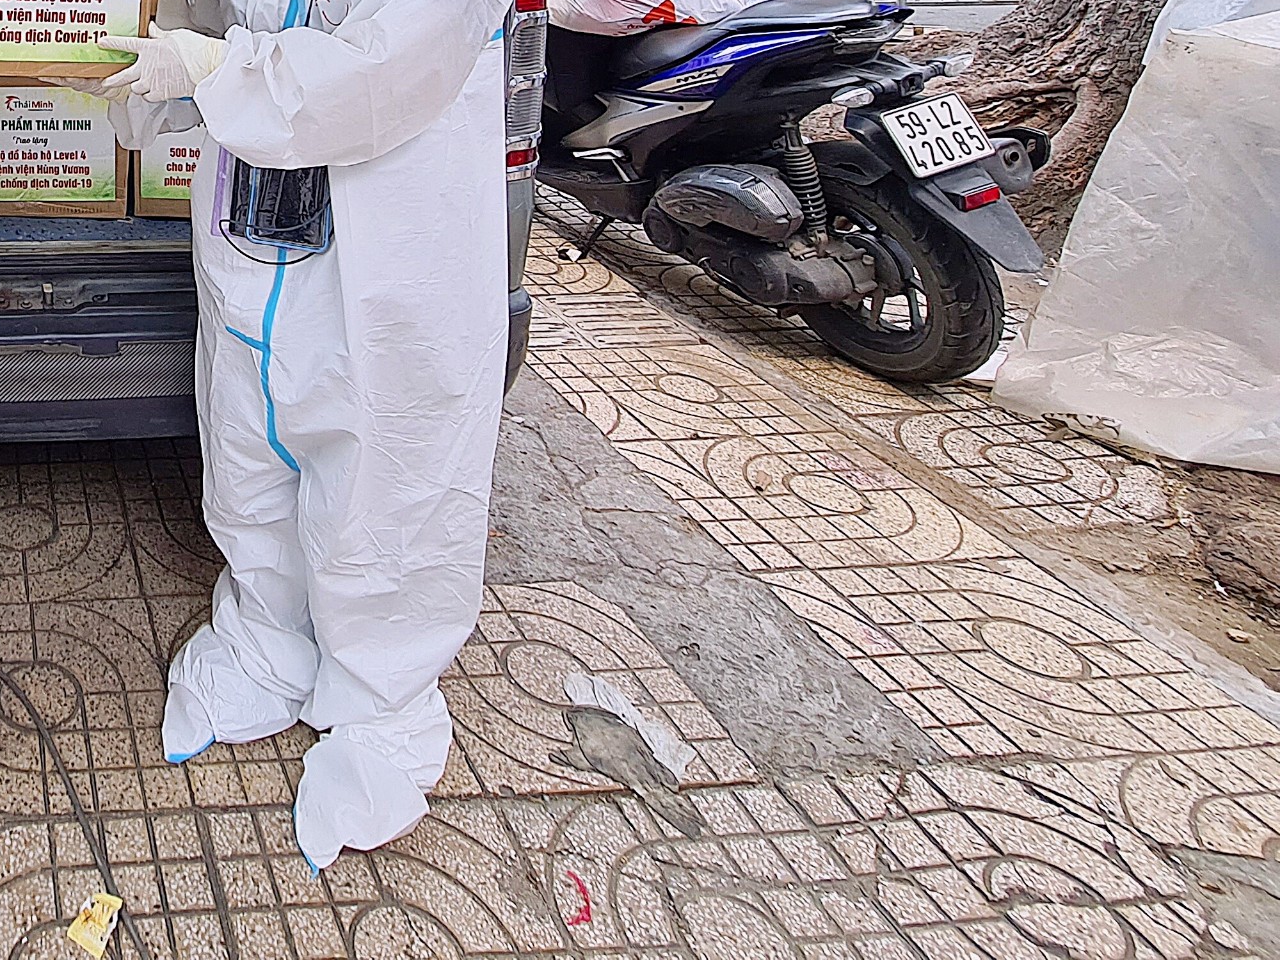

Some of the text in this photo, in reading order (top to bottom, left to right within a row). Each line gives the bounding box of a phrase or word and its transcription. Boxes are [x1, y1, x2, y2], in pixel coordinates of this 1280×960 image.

[6, 8, 32, 25] viện
[35, 8, 66, 25] Hùng
[70, 9, 106, 26] Vương
[25, 29, 52, 46] dịch
[1, 116, 33, 131] PHẨM
[36, 117, 60, 131] THÁI
[63, 120, 92, 131] MINH
[169, 147, 201, 160] 500 bộ
[908, 125, 985, 170] 420.85
[21, 149, 39, 160] bảo
[40, 150, 52, 162] hộ
[54, 150, 78, 160] Level
[80, 150, 87, 160] 4
[15, 164, 35, 177] viện
[36, 164, 60, 176] Hùng
[61, 164, 90, 176] Vương
[166, 162, 183, 172] cho
[0, 177, 28, 190] chống
[30, 178, 50, 190] dịch
[52, 178, 92, 189] Covid-19
[164, 176, 192, 187] phòng
